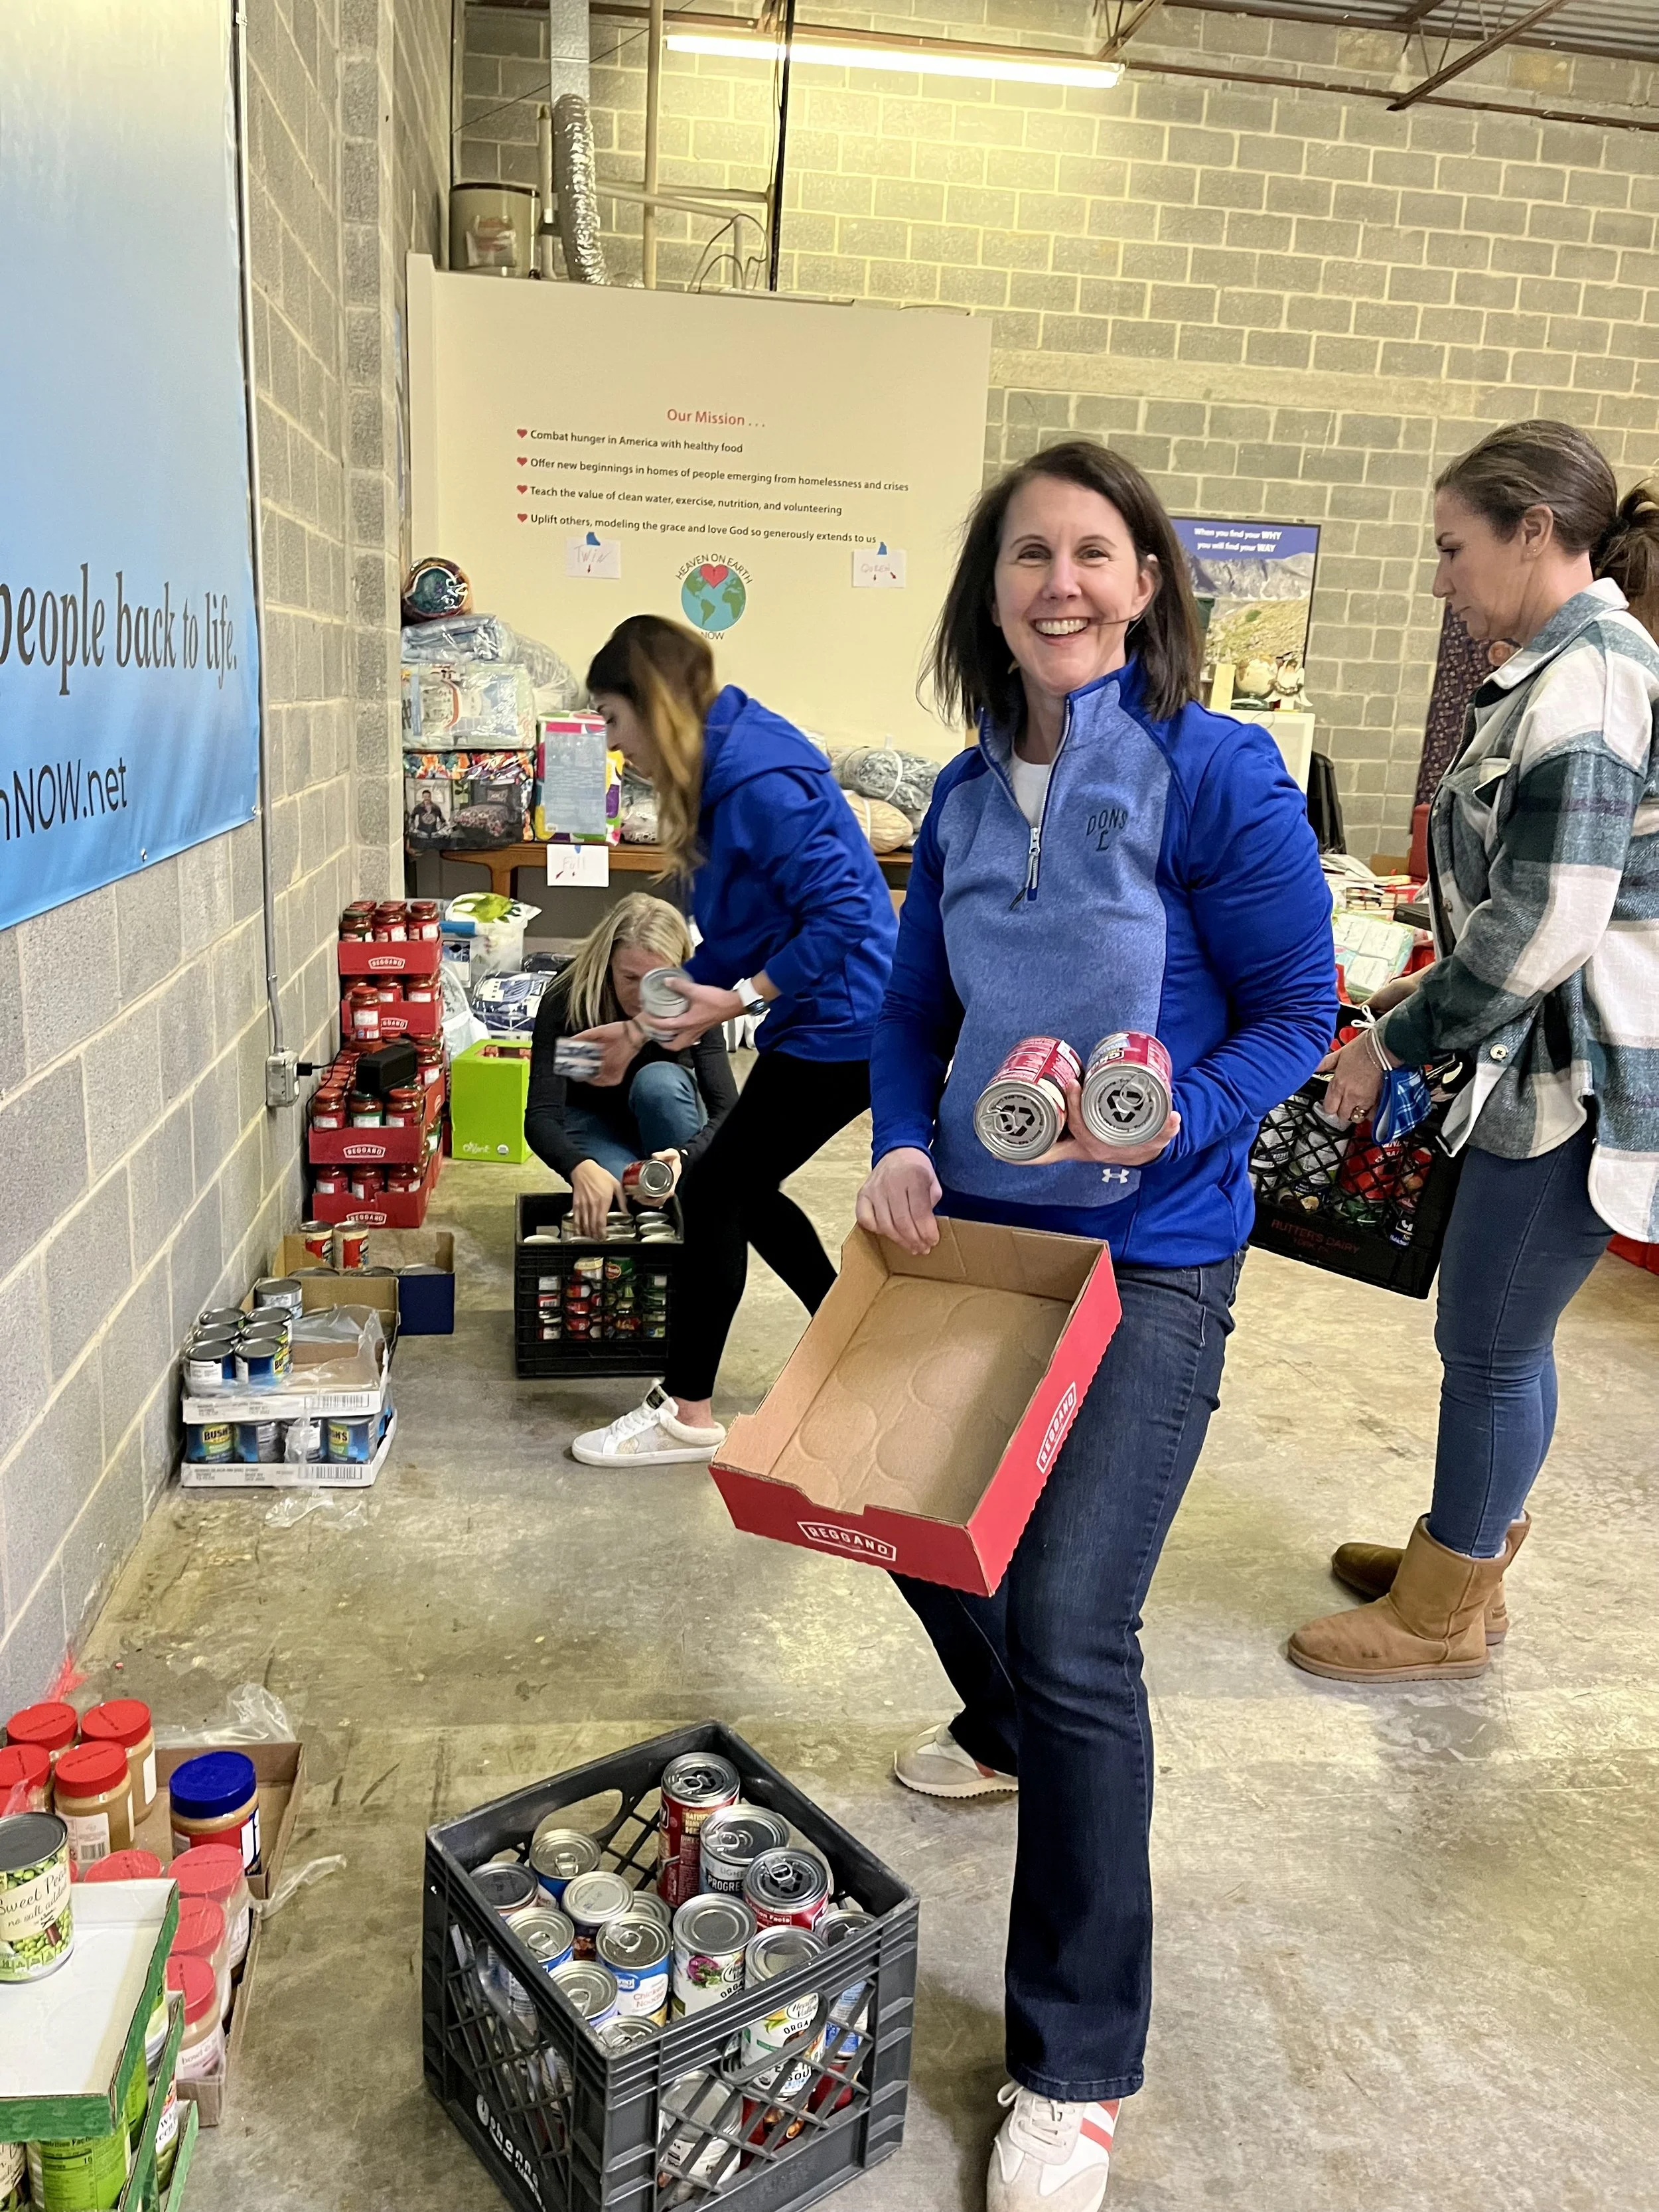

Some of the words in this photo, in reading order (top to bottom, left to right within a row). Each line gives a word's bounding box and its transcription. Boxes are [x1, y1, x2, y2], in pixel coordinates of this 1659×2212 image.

[667, 409, 691, 421] Our
[695, 411, 745, 425] Mission
[530, 429, 568, 441] Combat
[571, 432, 605, 445] hunger
[608, 435, 616, 444] in
[619, 436, 658, 447] America
[660, 439, 682, 449] with
[684, 441, 719, 453] healthy
[721, 443, 743, 453] food
[530, 458, 555, 469] Offer
[557, 461, 577, 470] new
[579, 461, 633, 476] beginnings
[635, 465, 644, 475] in
[647, 466, 678, 477] homes
[681, 468, 691, 477] of
[692, 471, 725, 481] people
[727, 473, 772, 484] emerging
[774, 474, 796, 484] from
[798, 476, 862, 488] homelessness
[864, 481, 881, 490] and
[883, 482, 908, 492] crises
[530, 486, 557, 497] Teach
[560, 488, 575, 498] the
[578, 489, 603, 500] value
[606, 491, 615, 500] of
[618, 492, 642, 502] clean
[645, 495, 674, 504] water,
[676, 497, 716, 508] exercise,
[718, 500, 762, 510] nutrition,
[764, 502, 781, 510] and
[784, 502, 842, 516] volunteering
[531, 514, 557, 525] Uplift
[560, 517, 593, 527] others,
[595, 519, 640, 531] modeling
[660, 524, 685, 534] grace
[687, 524, 705, 533] and
[707, 524, 727, 534] love
[729, 526, 749, 535] God
[763, 530, 814, 542] generously
[816, 532, 852, 542] extends
[1262, 531, 1282, 540] WHY
[1257, 544, 1277, 552] WAY
[676, 553, 709, 580] HEAVEN
[711, 553, 726, 563] ON
[727, 557, 753, 585] EARTH
[116, 571, 176, 668] back
[182, 597, 198, 670] to
[204, 591, 238, 689] life.
[701, 631, 725, 640] NOW
[1086, 808, 1128, 836] DONS
[1041, 1392, 1074, 1464] REGGANO
[808, 1526, 889, 1555] REGGANO
[707, 1874, 743, 1891] PROGRE
[0, 1887, 42, 1915] Sweet
[721, 1980, 745, 1998] ORGA
[784, 2020, 809, 2034] ORGA
[788, 2068, 810, 2082] SOU
